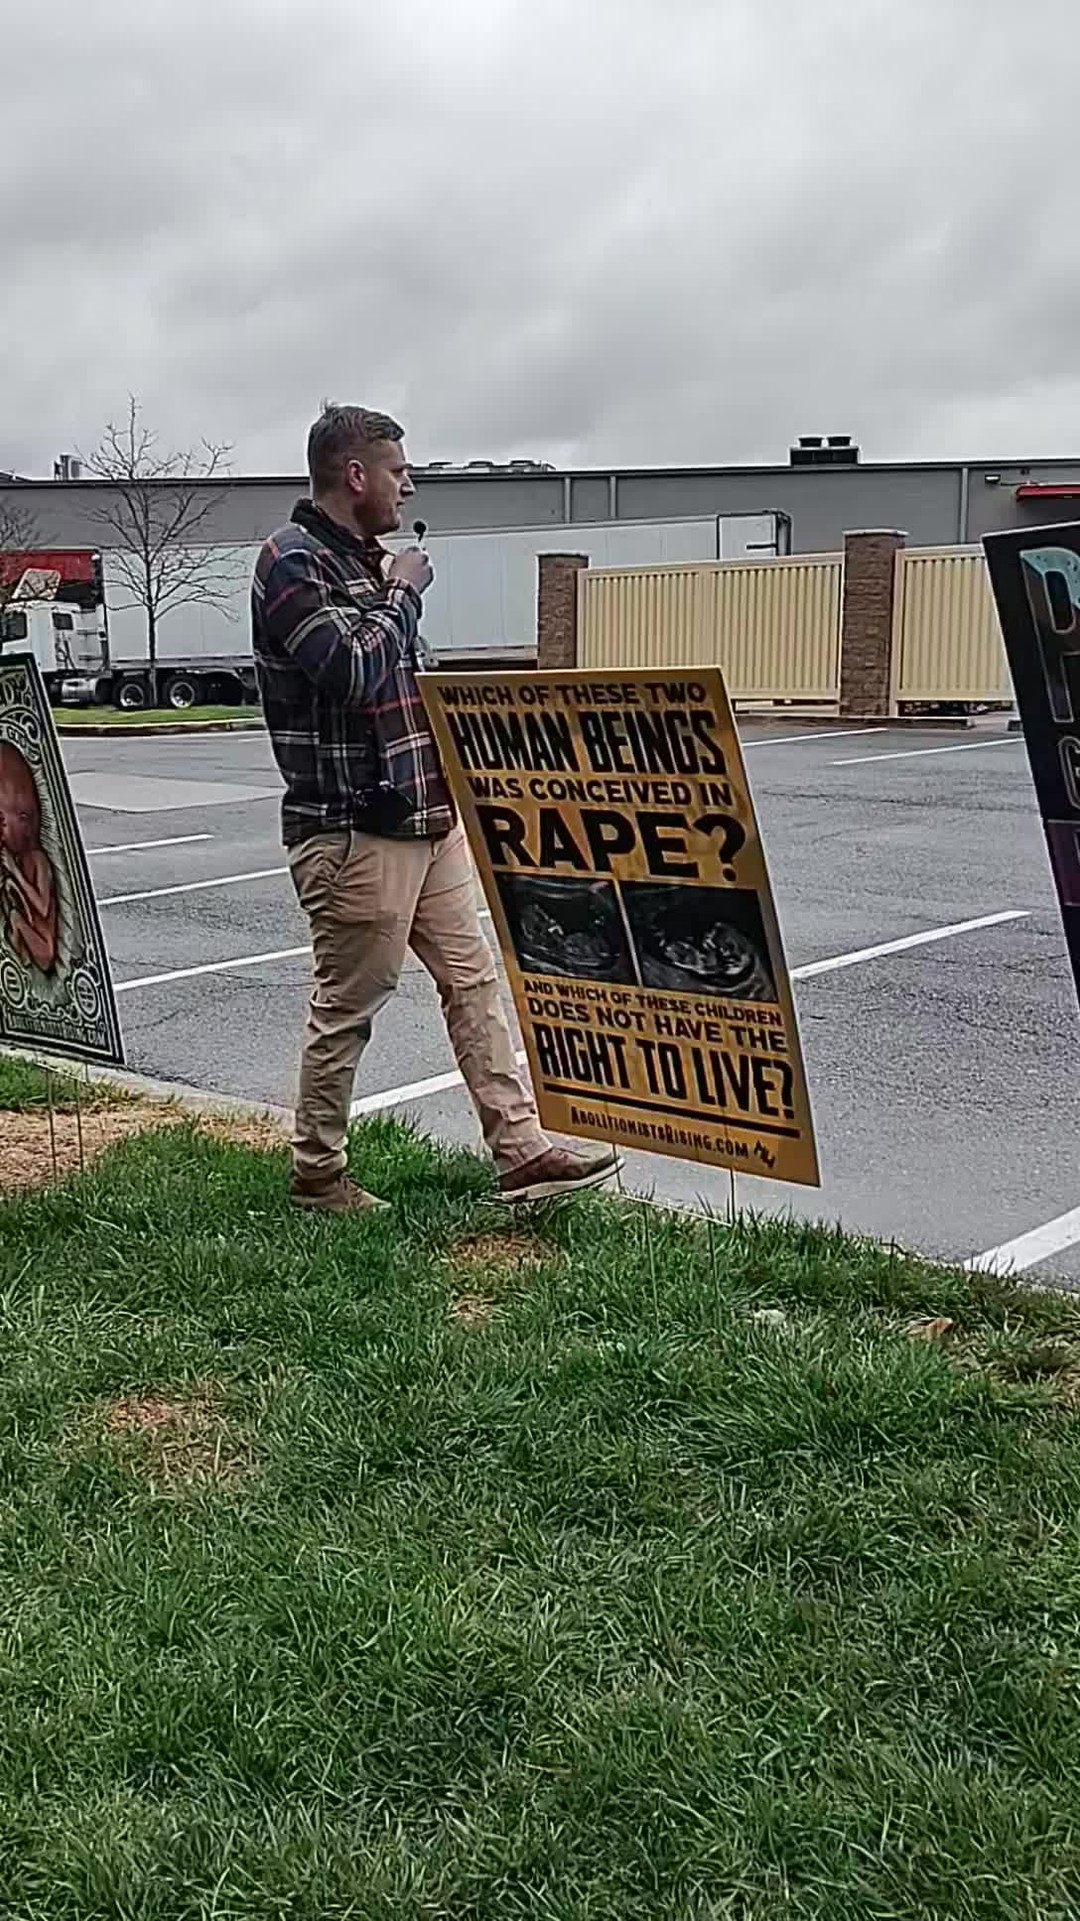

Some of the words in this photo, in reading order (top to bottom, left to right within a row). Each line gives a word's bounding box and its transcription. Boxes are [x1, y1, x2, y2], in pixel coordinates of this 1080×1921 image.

[437, 685, 513, 706] WHICH
[524, 687, 549, 706] OF
[558, 686, 640, 705] THESE
[647, 683, 707, 704] TWO
[446, 711, 580, 772] HUMAN
[579, 710, 726, 775] BEINGS
[467, 778, 524, 799] WAS
[530, 779, 692, 804] CONCEIVED
[701, 783, 731, 806] IN
[476, 805, 746, 882] RAPE?
[524, 979, 553, 995] AND
[556, 983, 606, 1003] WHICH
[612, 993, 632, 1006] OF
[635, 994, 691, 1014] THESE
[696, 1003, 783, 1026] CHILDREN
[528, 998, 589, 1021] DOES
[600, 1008, 646, 1031] NOT
[655, 1015, 724, 1043] HAVE
[729, 1026, 787, 1053] THE
[533, 1022, 631, 1090] RIGHT
[637, 1039, 688, 1101] TO
[691, 1048, 795, 1120] LIVE?
